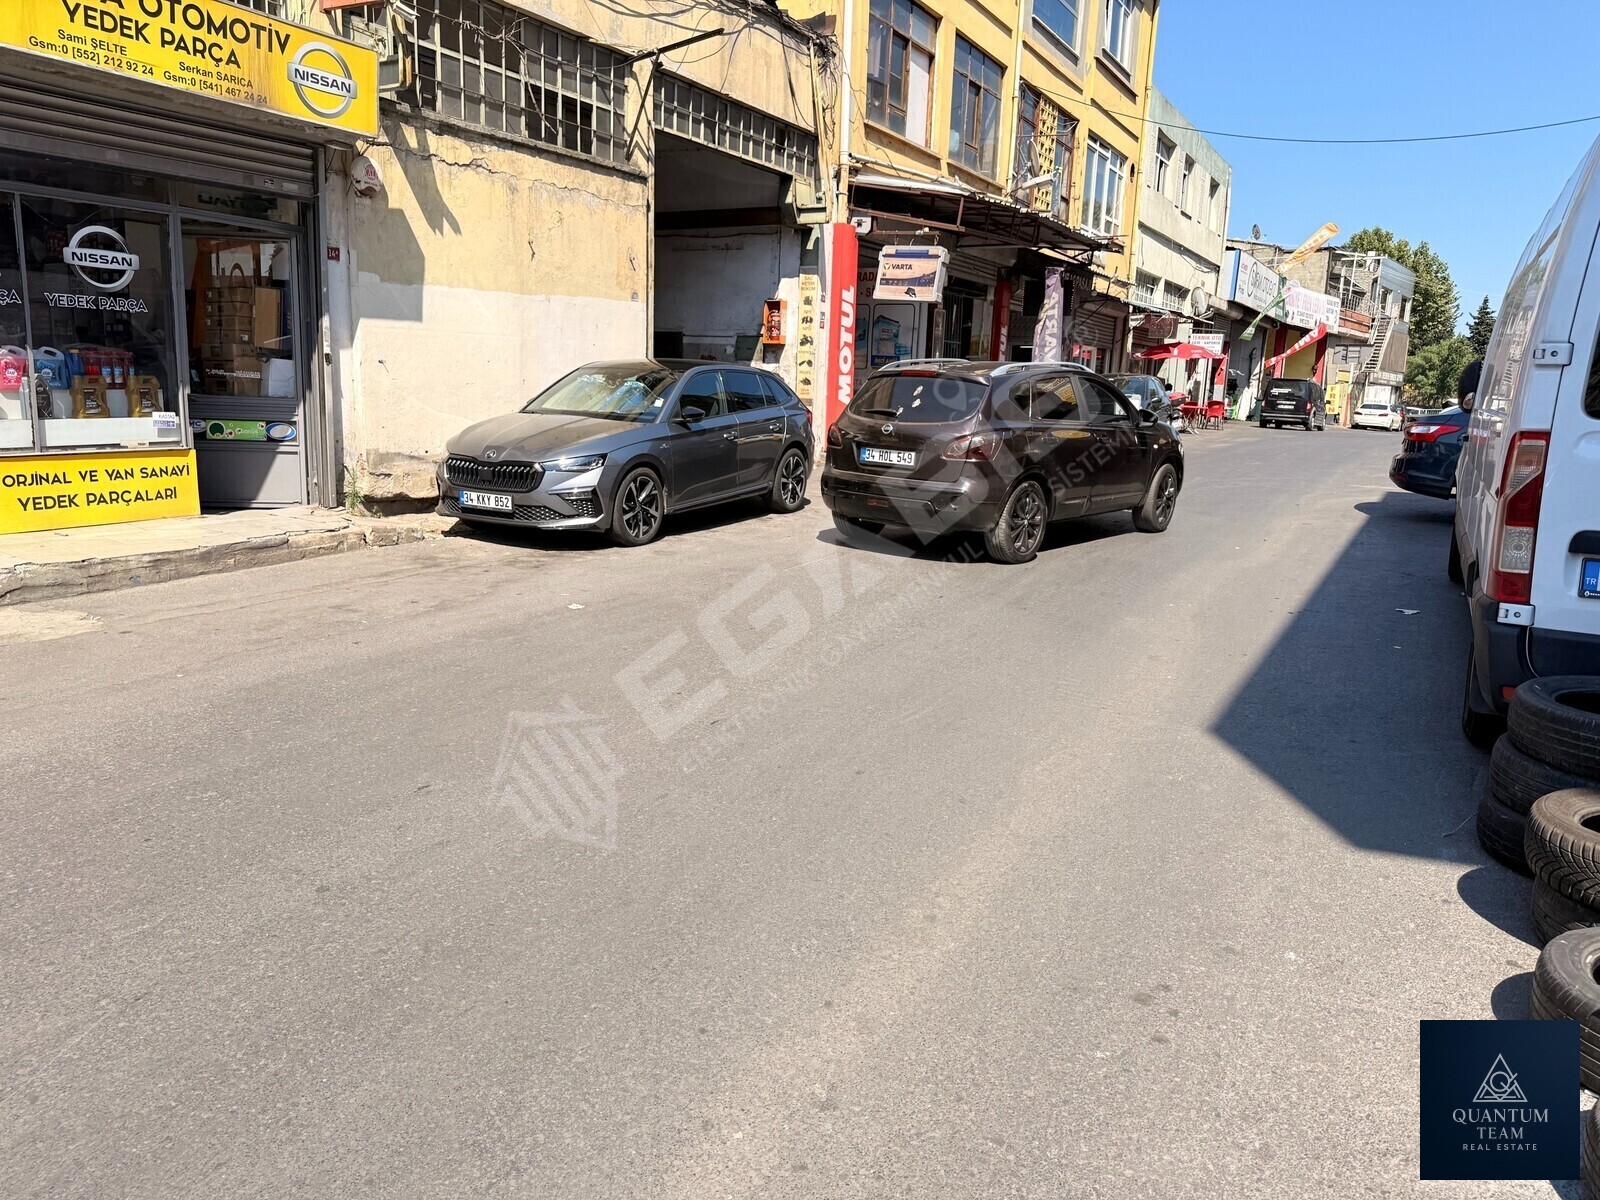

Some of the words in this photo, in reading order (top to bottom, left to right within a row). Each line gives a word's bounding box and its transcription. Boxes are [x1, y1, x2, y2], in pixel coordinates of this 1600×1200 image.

[61, 1, 151, 44] YEDEK
[160, 27, 242, 70] PARÇA
[140, 0, 290, 56] OTOMOTİV
[58, 29, 89, 46] Sami
[90, 37, 128, 57] ŞELTE
[72, 46, 101, 65] [552]
[103, 54, 124, 68] 212
[126, 59, 139, 72] 92
[141, 64, 154, 77] 24
[178, 61, 214, 80] Serkan
[216, 68, 254, 90] SARICA
[293, 67, 353, 95] NISSAN
[199, 79, 224, 96] [541]
[225, 85, 243, 98] 467
[244, 90, 256, 102] 24
[70, 251, 133, 267] NISSAN
[891, 262, 913, 271] VARTA
[44, 292, 97, 309] YEDEK
[98, 296, 149, 314] PARÇA
[838, 284, 855, 405] MOTUL
[1328, 386, 1337, 413] FREN
[865, 448, 876, 460] 34
[878, 449, 894, 463] HOL
[896, 451, 913, 464] 549
[1, 469, 73, 488] ORJİNAL
[79, 469, 99, 482] VE
[107, 467, 137, 480] YAN
[140, 462, 191, 479] SANAYİ
[17, 493, 80, 512] YEDEK
[86, 486, 178, 507] PARÇALARI
[464, 491, 475, 504] 34
[476, 493, 492, 506] KKY
[494, 495, 510, 508] 852
[1585, 577, 1597, 586] TR
